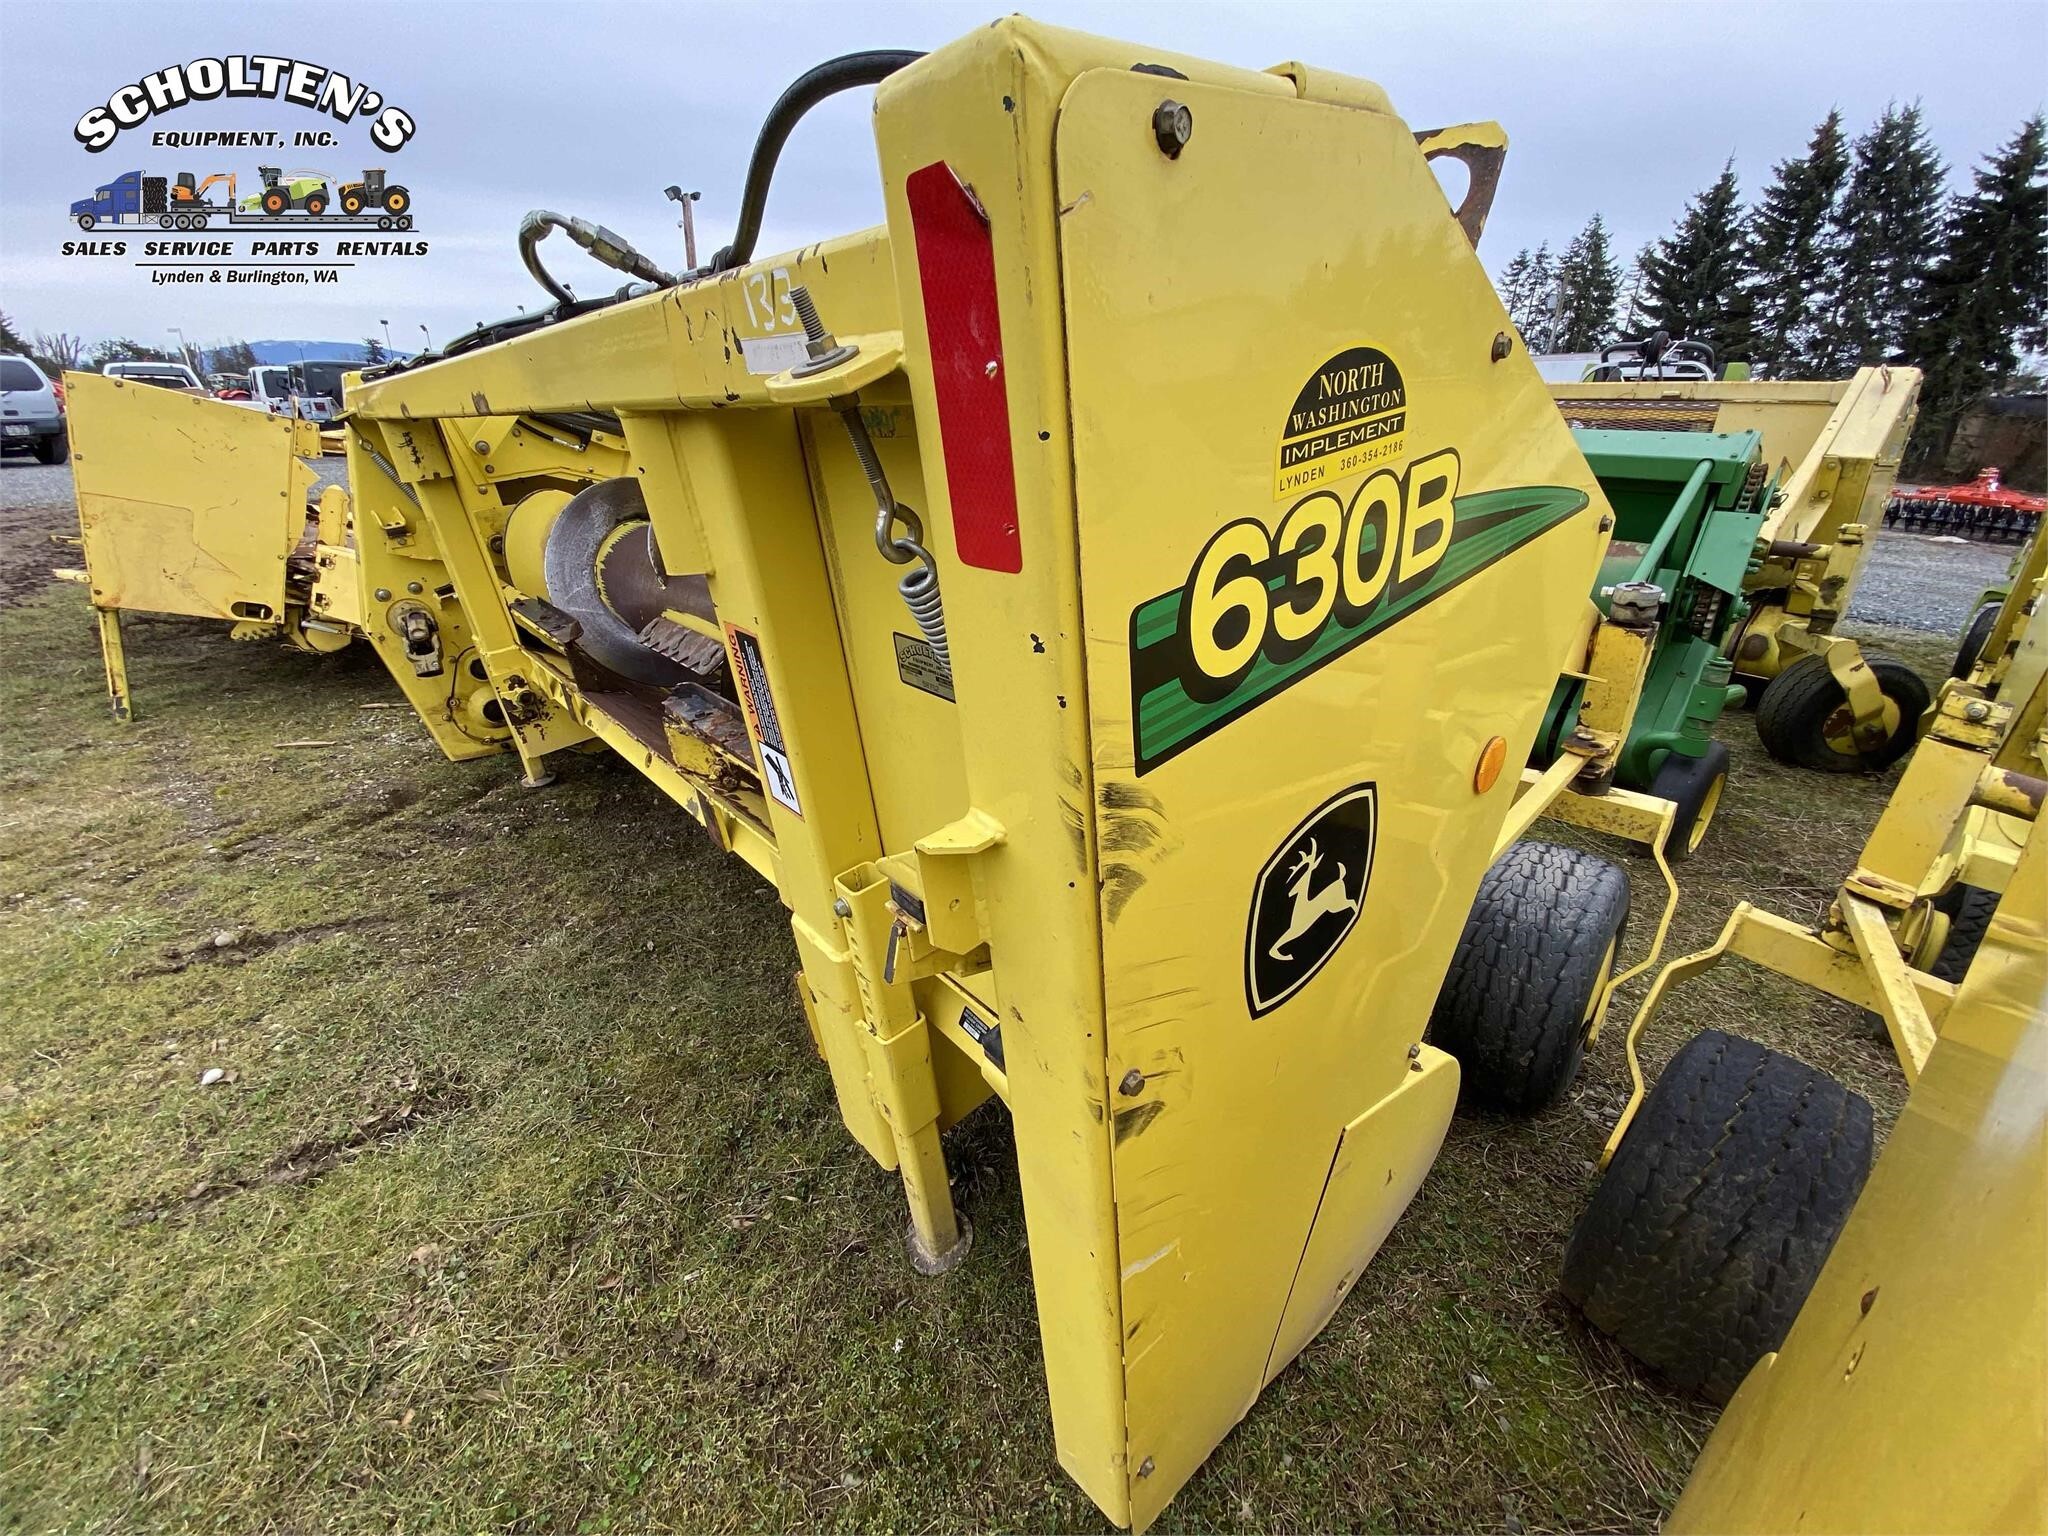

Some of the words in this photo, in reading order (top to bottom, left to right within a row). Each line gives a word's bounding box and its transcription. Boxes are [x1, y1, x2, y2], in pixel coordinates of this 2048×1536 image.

[1318, 362, 1385, 400] NORTH
[1292, 388, 1402, 432] WASHINGTON
[1279, 465, 1325, 492] LYNDEN
[1340, 439, 1404, 471] 360-354-2186
[1285, 416, 1402, 465] IMPLEMENT
[1186, 447, 1461, 694] 630B
[728, 634, 756, 714] WARNING
